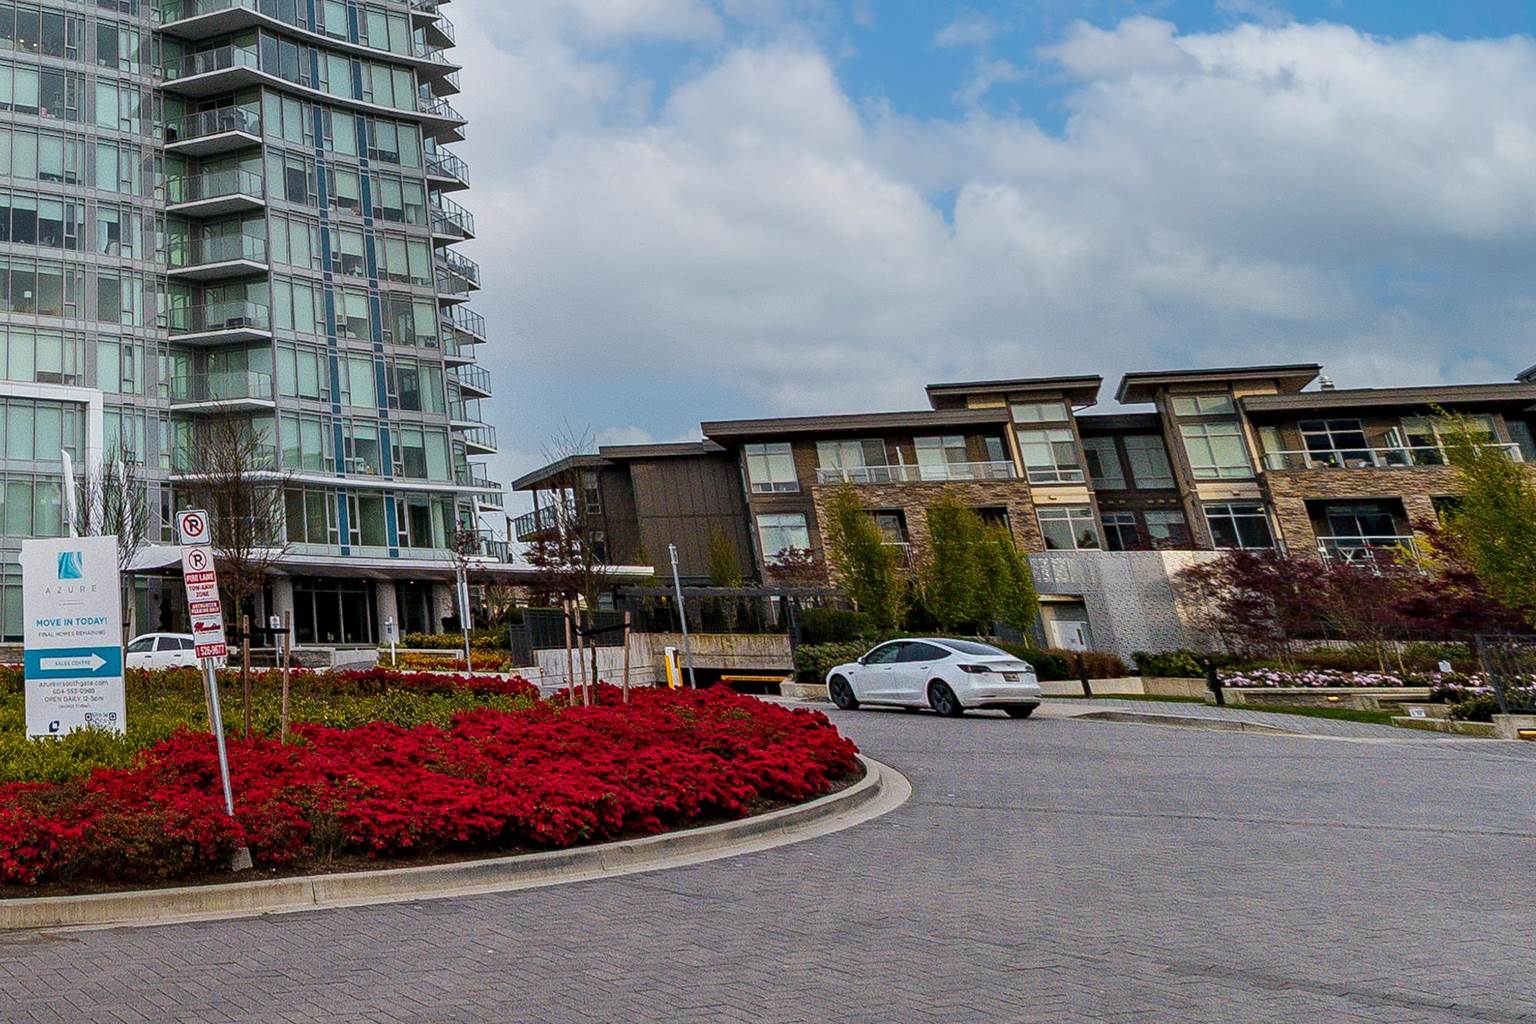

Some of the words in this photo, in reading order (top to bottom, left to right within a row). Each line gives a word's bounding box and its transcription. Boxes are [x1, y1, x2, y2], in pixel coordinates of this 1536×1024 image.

[186, 574, 199, 583] FIRE
[199, 572, 214, 581] LANE
[45, 584, 97, 594] AZURE
[36, 618, 62, 627] MOVE
[64, 618, 73, 626] IN
[75, 617, 108, 626] TODAY!
